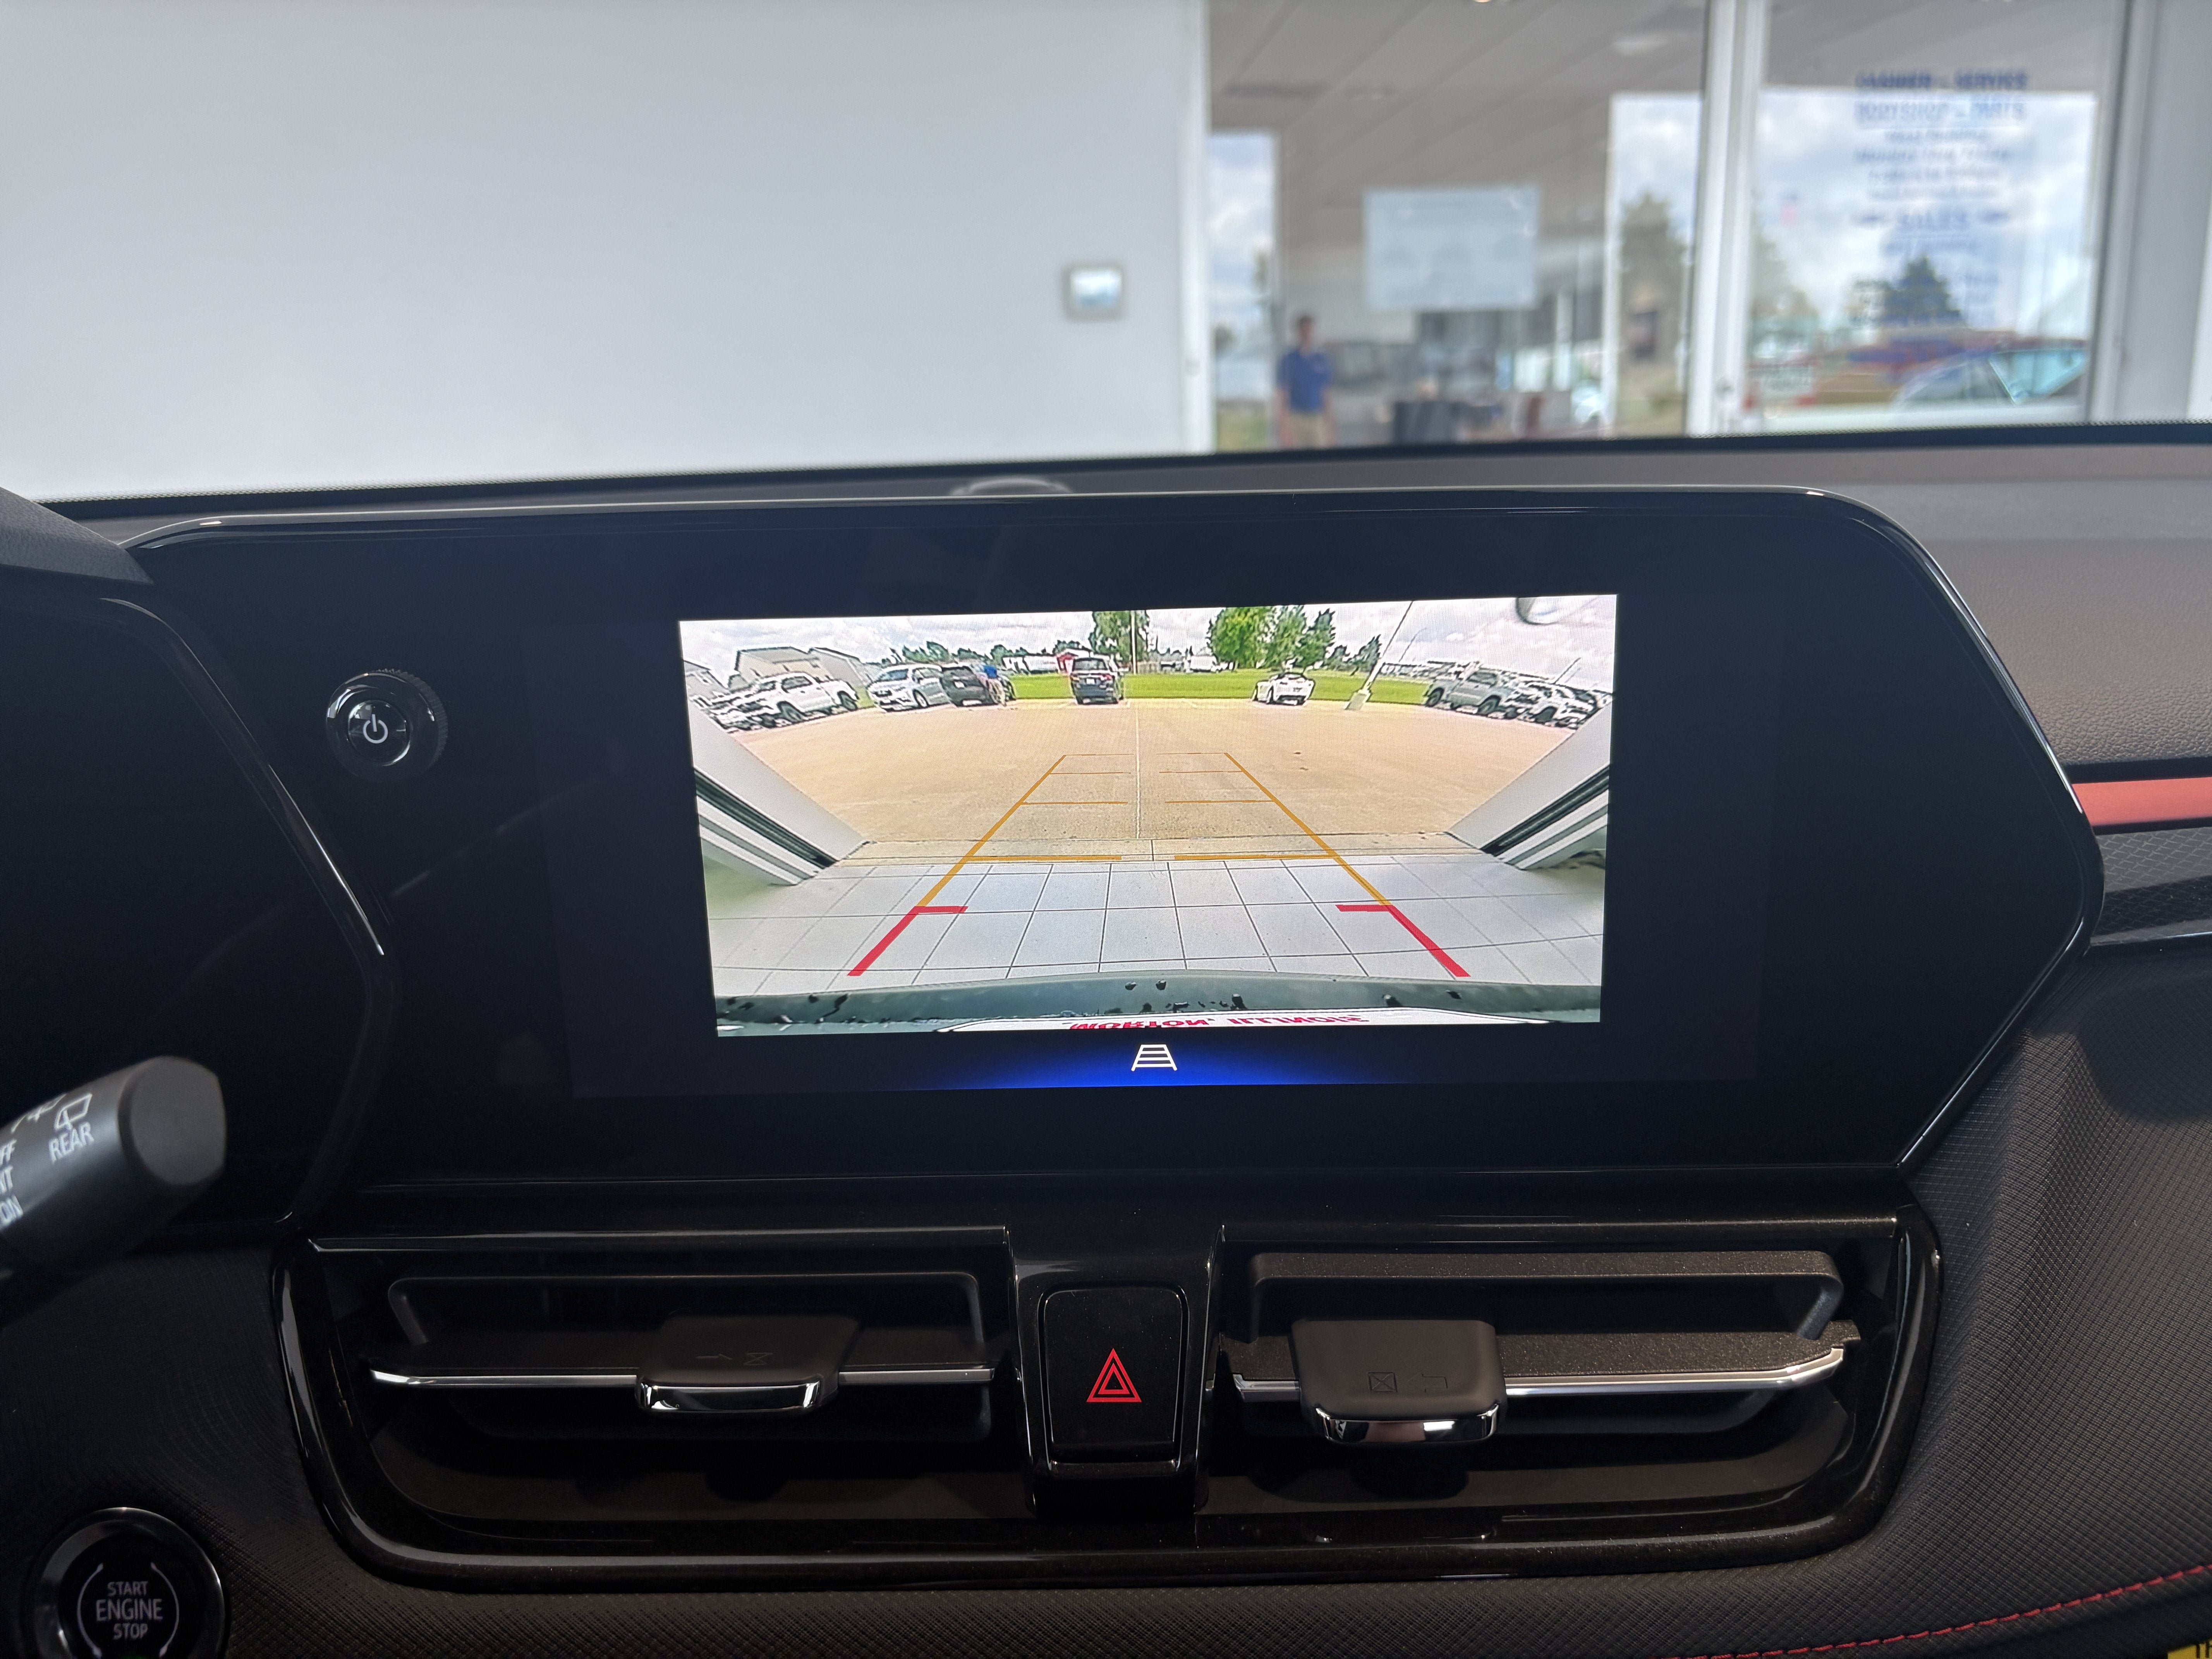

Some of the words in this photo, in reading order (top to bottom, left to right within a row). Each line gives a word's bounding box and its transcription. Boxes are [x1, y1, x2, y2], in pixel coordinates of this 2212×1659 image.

[49, 1122, 94, 1162] REAR
[107, 1581, 148, 1596] START
[96, 1598, 163, 1621] ENGINE
[113, 1623, 148, 1640] STOP
